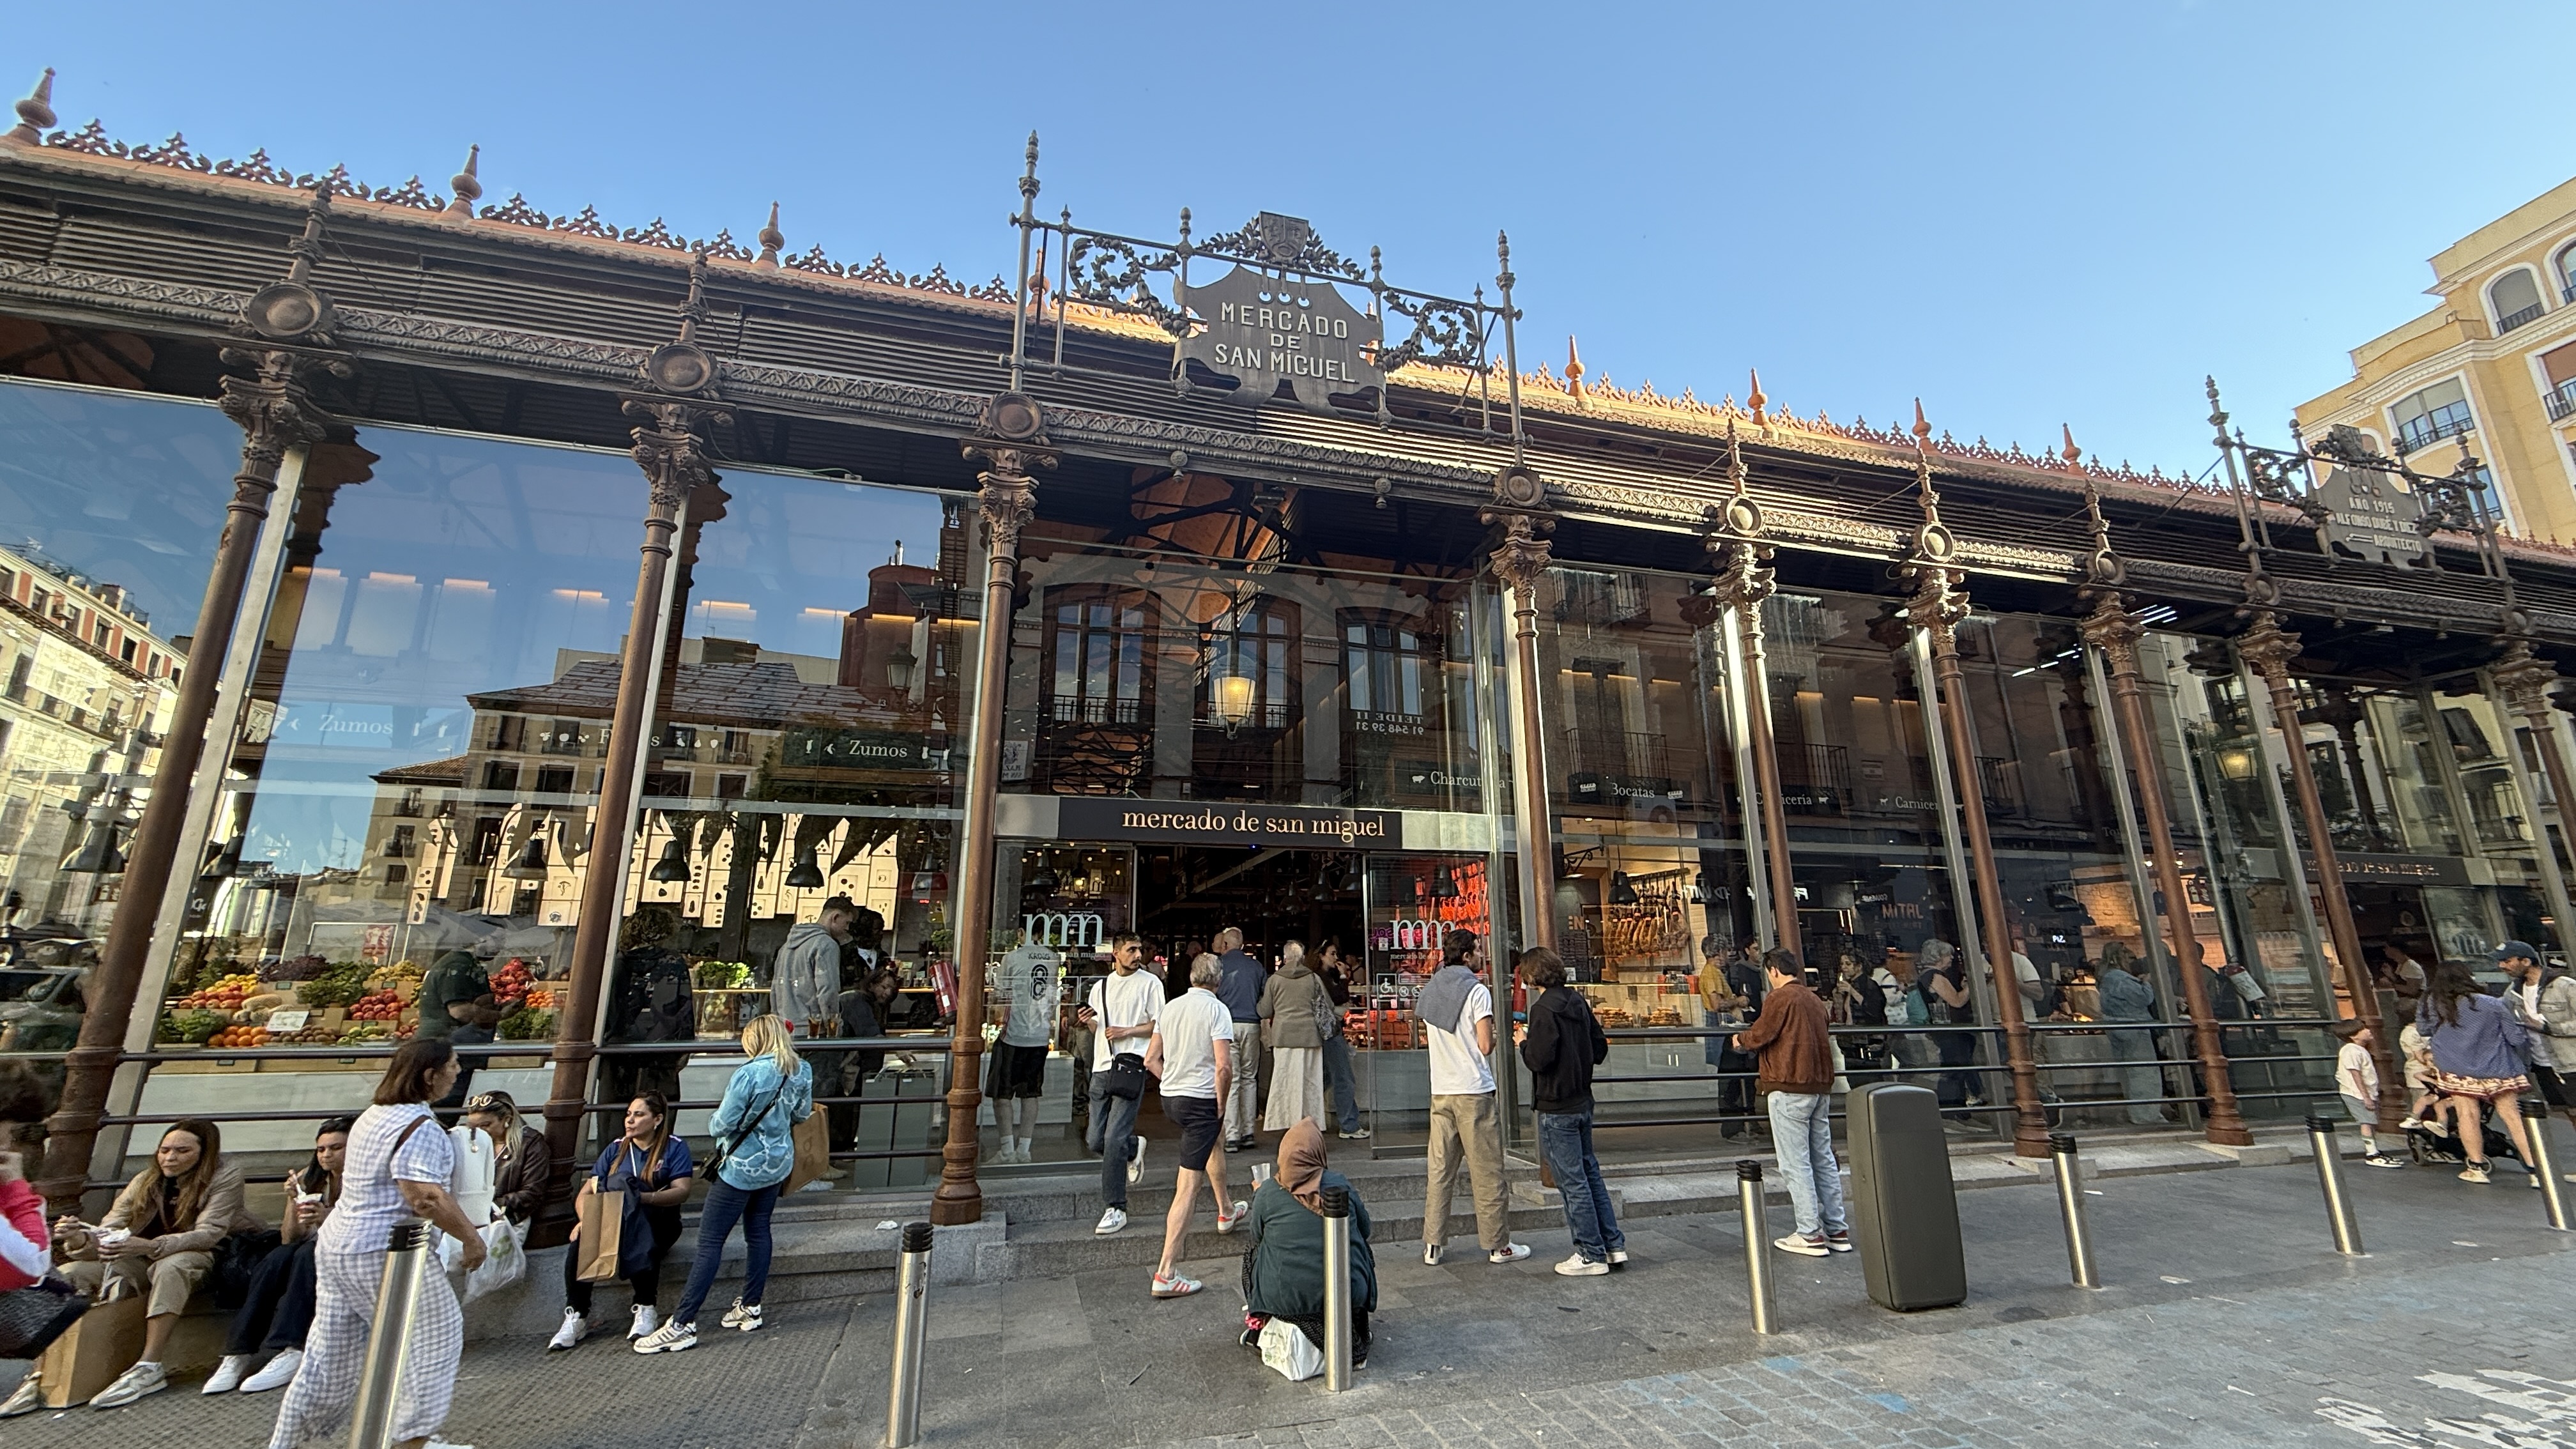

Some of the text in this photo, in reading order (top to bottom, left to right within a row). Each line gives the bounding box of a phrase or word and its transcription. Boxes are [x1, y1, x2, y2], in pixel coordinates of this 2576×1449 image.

[1221, 302, 1348, 339] MERCADO
[1270, 333, 1301, 349] DE
[1215, 343, 1262, 369] SAN
[2349, 494, 2395, 514] AÑO 1915
[2336, 512, 2372, 528] ALFONSO
[2392, 520, 2399, 532] Y
[319, 714, 394, 734] Zumos
[849, 740, 908, 758] Zumos
[1609, 782, 1655, 799] Bocatas
[1122, 808, 1386, 843] mercado de san miguel
